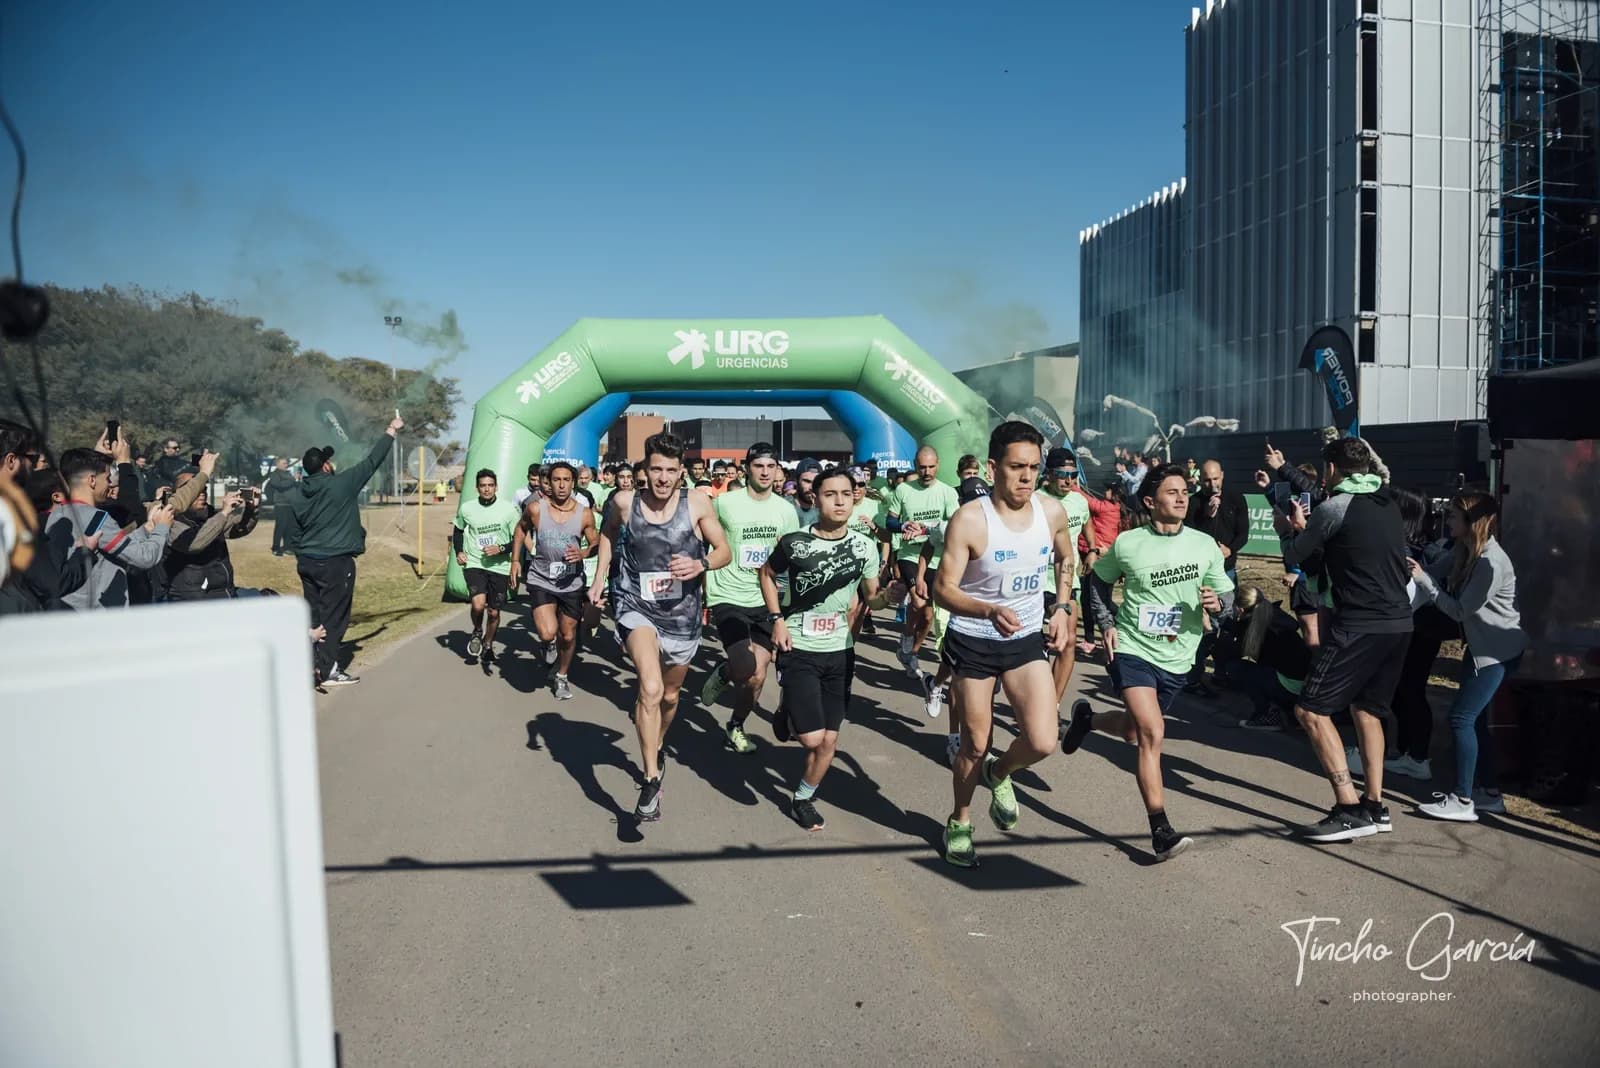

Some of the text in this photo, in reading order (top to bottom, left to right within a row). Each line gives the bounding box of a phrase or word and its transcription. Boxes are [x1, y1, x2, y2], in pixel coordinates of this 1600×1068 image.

[715, 330, 789, 355] URG
[533, 351, 572, 385] URG
[716, 357, 788, 368] URGENCIAS
[907, 369, 945, 404] URG
[876, 459, 912, 470] ÓRDOBA
[742, 526, 778, 534] MARATÓN
[742, 532, 777, 540] SOLIDARIA
[1150, 563, 1199, 580] MARATÓN
[1012, 574, 1040, 592] 816
[1151, 572, 1200, 588] SOLIDARIA
[812, 618, 836, 632] 195
[1146, 611, 1177, 628] 787
